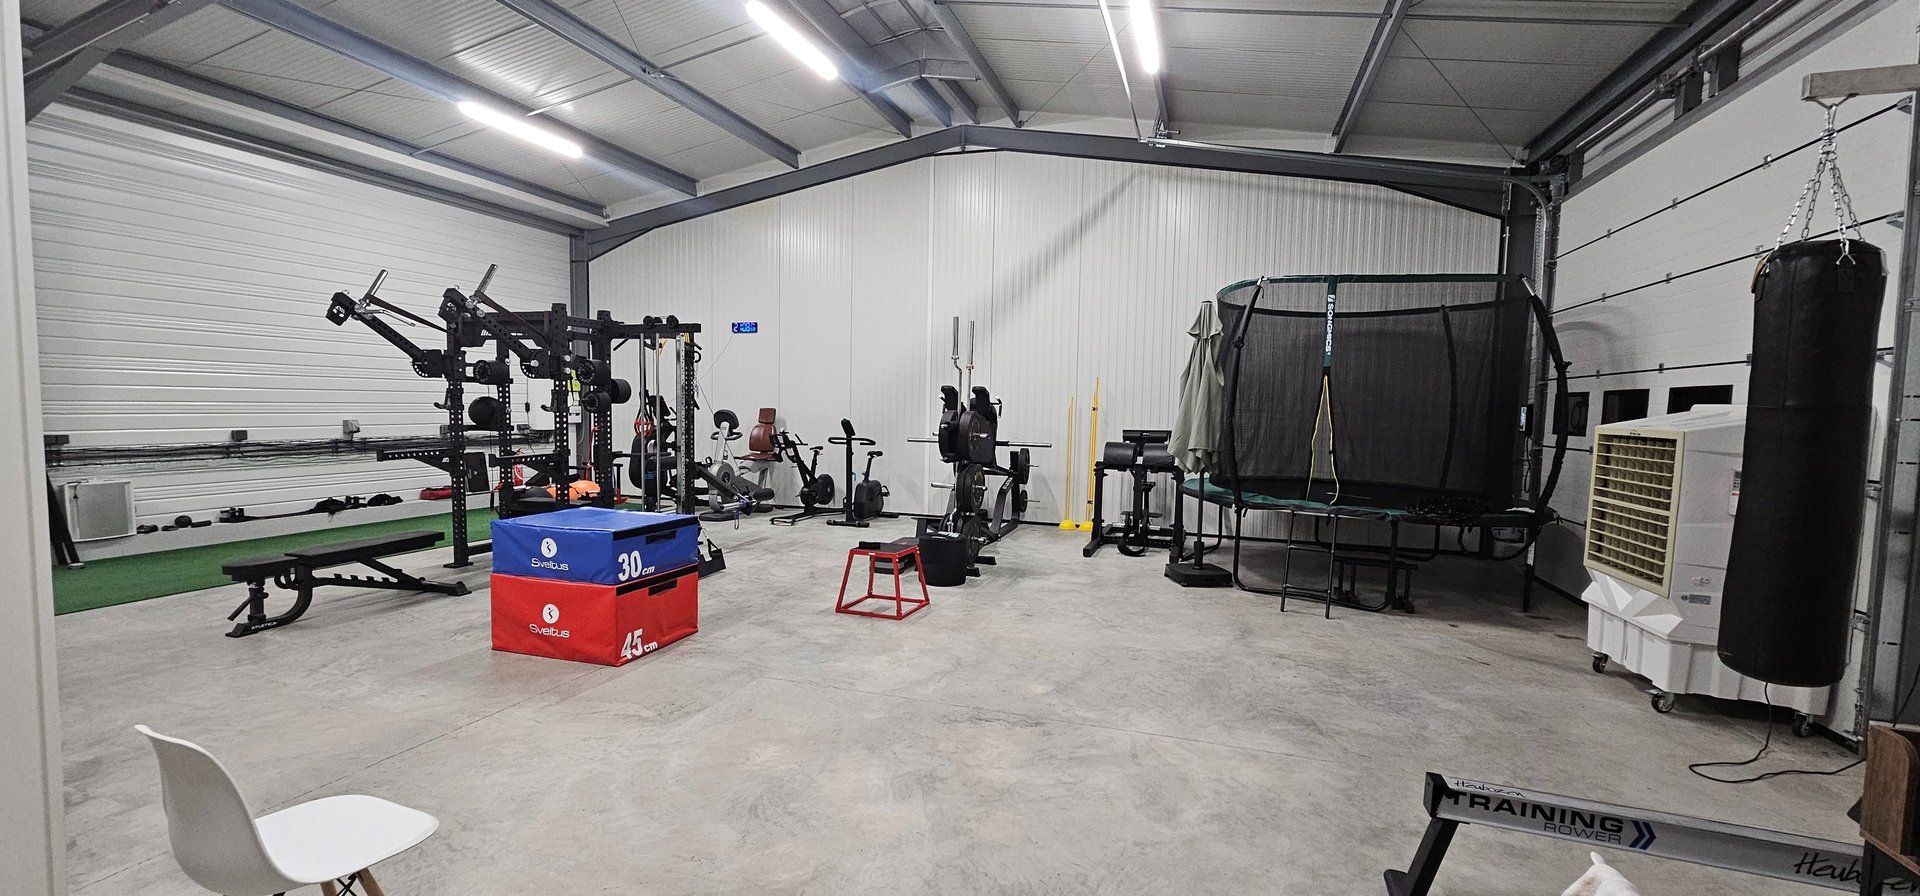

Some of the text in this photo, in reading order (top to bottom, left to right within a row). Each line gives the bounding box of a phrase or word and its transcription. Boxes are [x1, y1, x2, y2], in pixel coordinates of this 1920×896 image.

[1325, 302, 1335, 353] SONGMICS
[531, 558, 569, 571] Sveltus
[617, 549, 656, 582] 30 cm
[529, 623, 569, 637] Sveltus
[620, 628, 658, 660] 45 cm
[1447, 789, 1624, 833] TRAINING
[1544, 822, 1622, 845] ROWER
